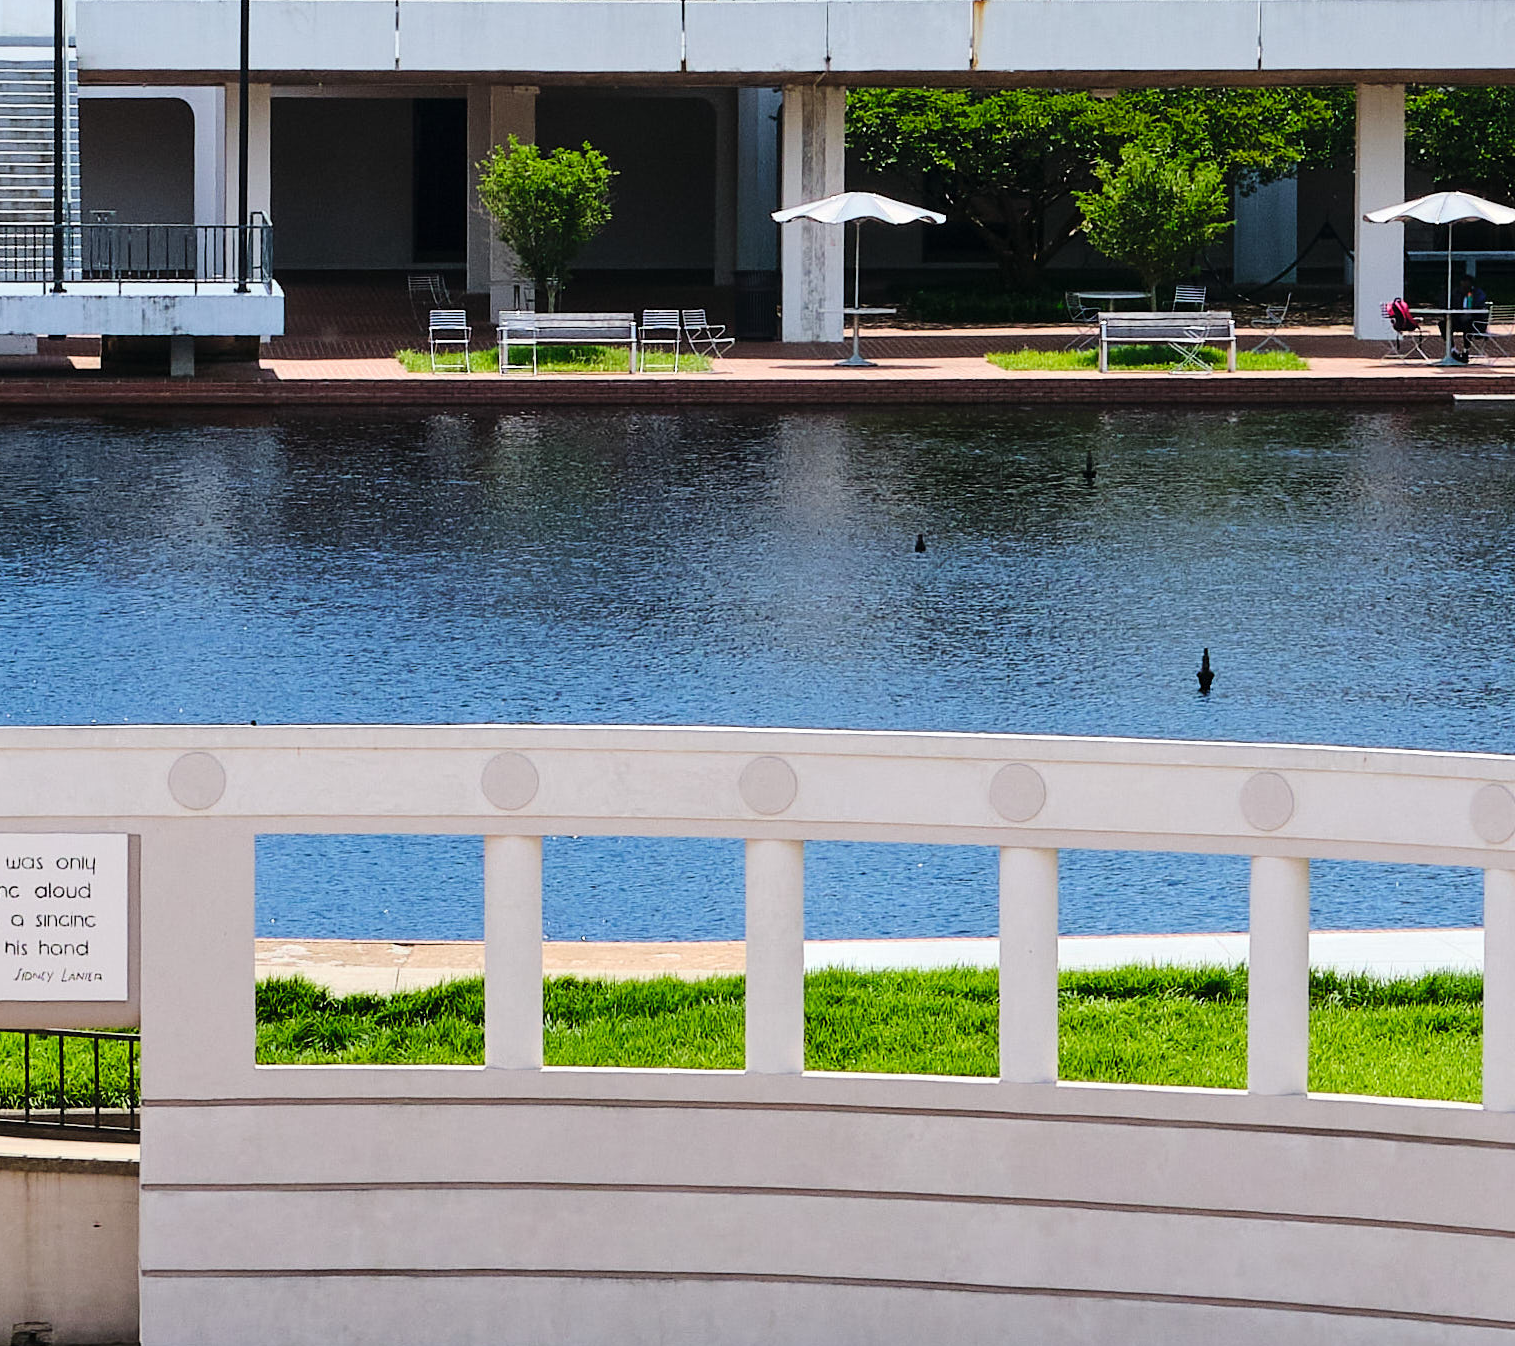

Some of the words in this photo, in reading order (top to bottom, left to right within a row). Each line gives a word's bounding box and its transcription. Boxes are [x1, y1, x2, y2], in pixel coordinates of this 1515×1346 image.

[5, 856, 44, 870] was
[55, 856, 96, 875] only
[34, 881, 92, 900] aloud
[10, 913, 25, 928] a
[4, 939, 28, 956] his
[38, 939, 90, 957] hand
[61, 967, 103, 983] LANIER
